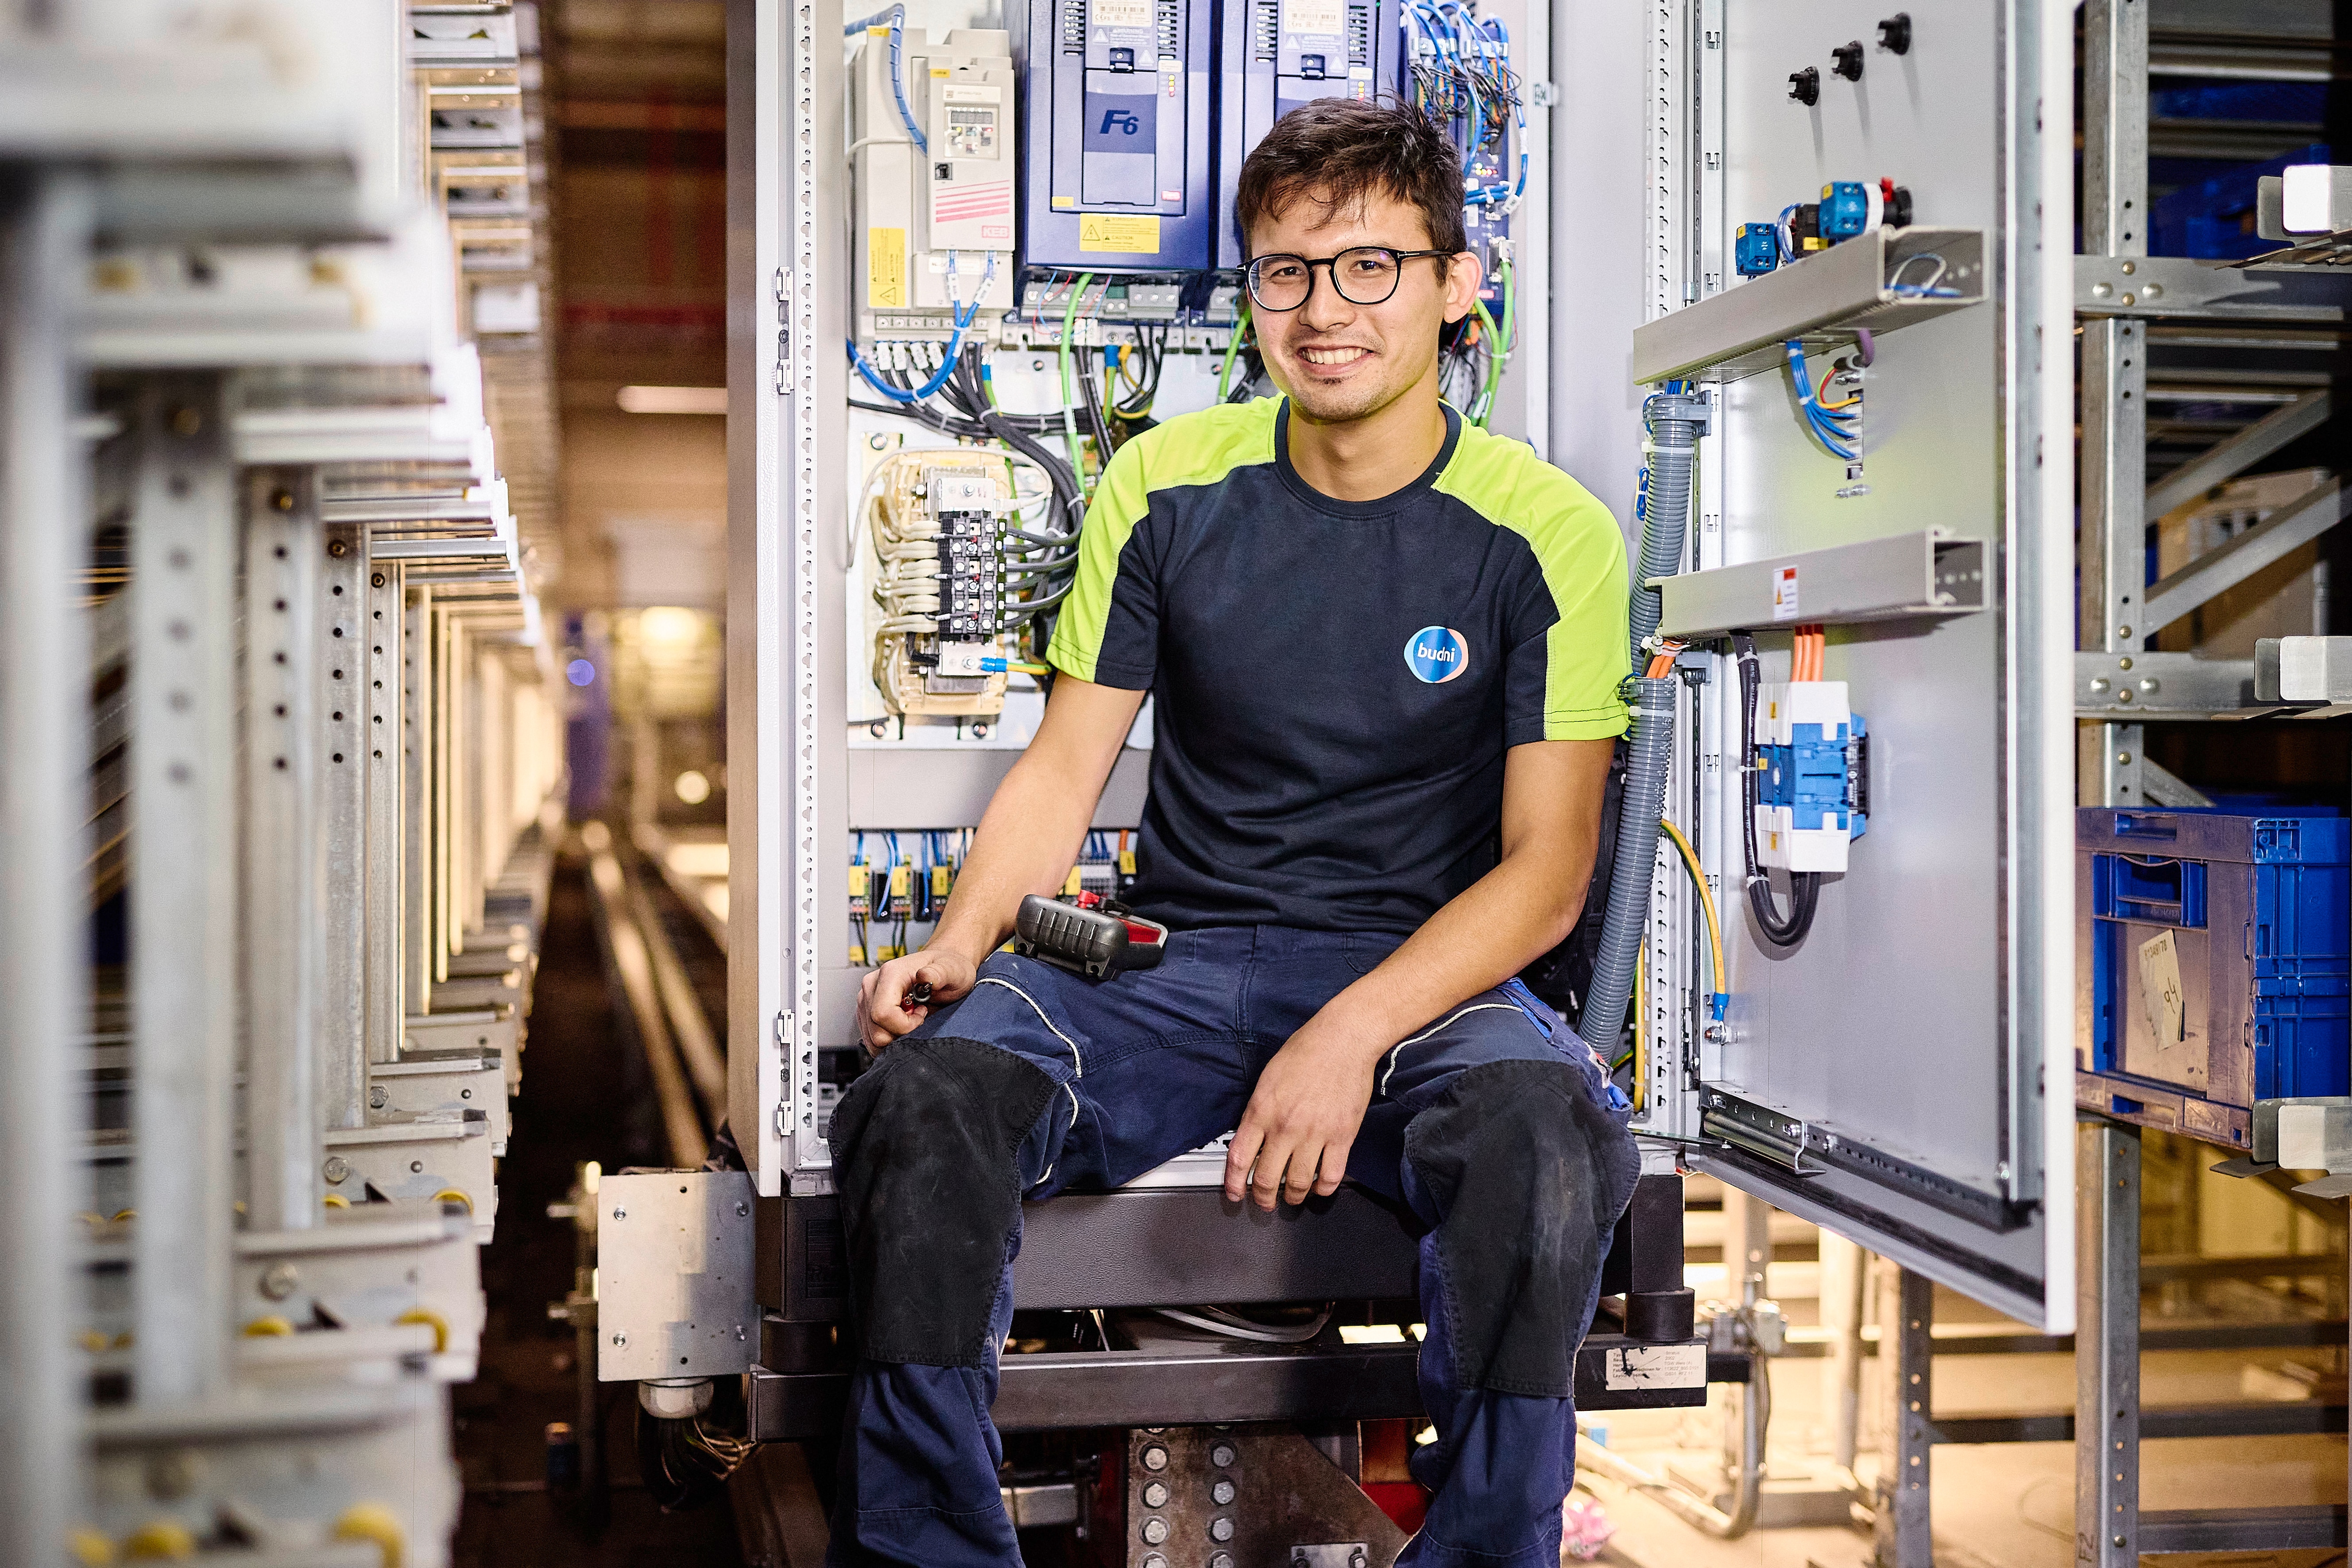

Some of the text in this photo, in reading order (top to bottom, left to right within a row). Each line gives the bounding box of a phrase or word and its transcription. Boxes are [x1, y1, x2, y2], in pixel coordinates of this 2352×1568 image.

[1100, 110, 1139, 135] F6
[983, 227, 1009, 238] KEB
[1417, 642, 1455, 663] budni
[2164, 977, 2179, 1014] 94
